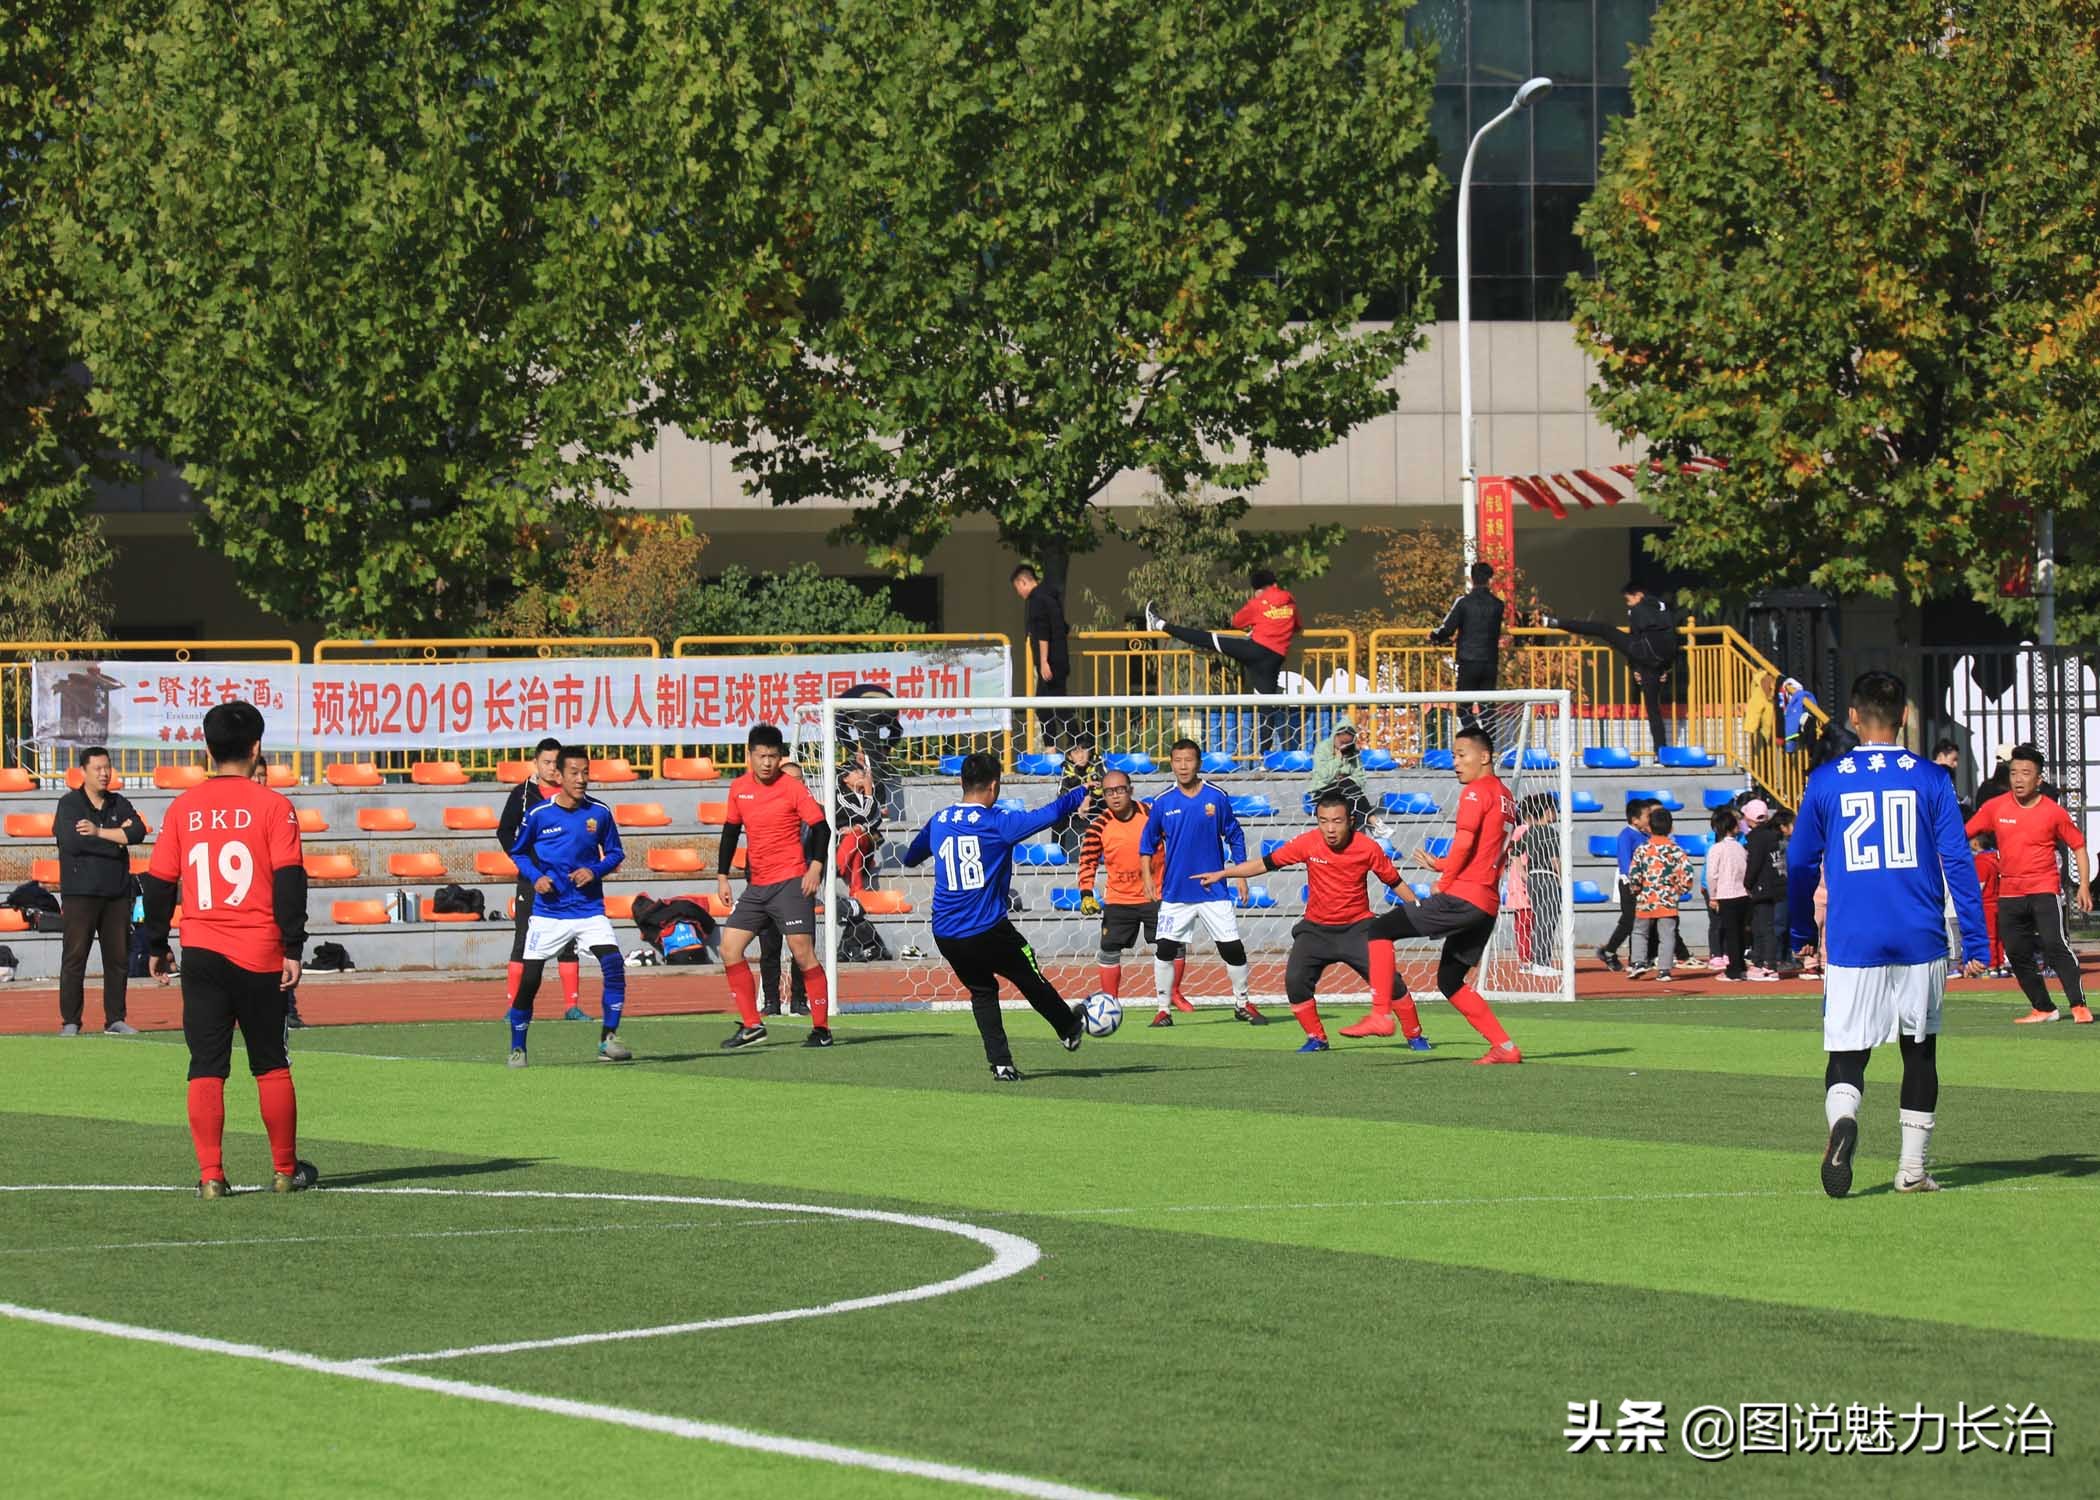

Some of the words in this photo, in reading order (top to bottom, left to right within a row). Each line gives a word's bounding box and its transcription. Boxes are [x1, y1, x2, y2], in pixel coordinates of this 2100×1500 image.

[1837, 753, 1917, 774] 老革命
[188, 808, 252, 832] BKD
[1840, 789, 1919, 872] 20
[188, 840, 254, 911] 19
[938, 835, 985, 891] 18
